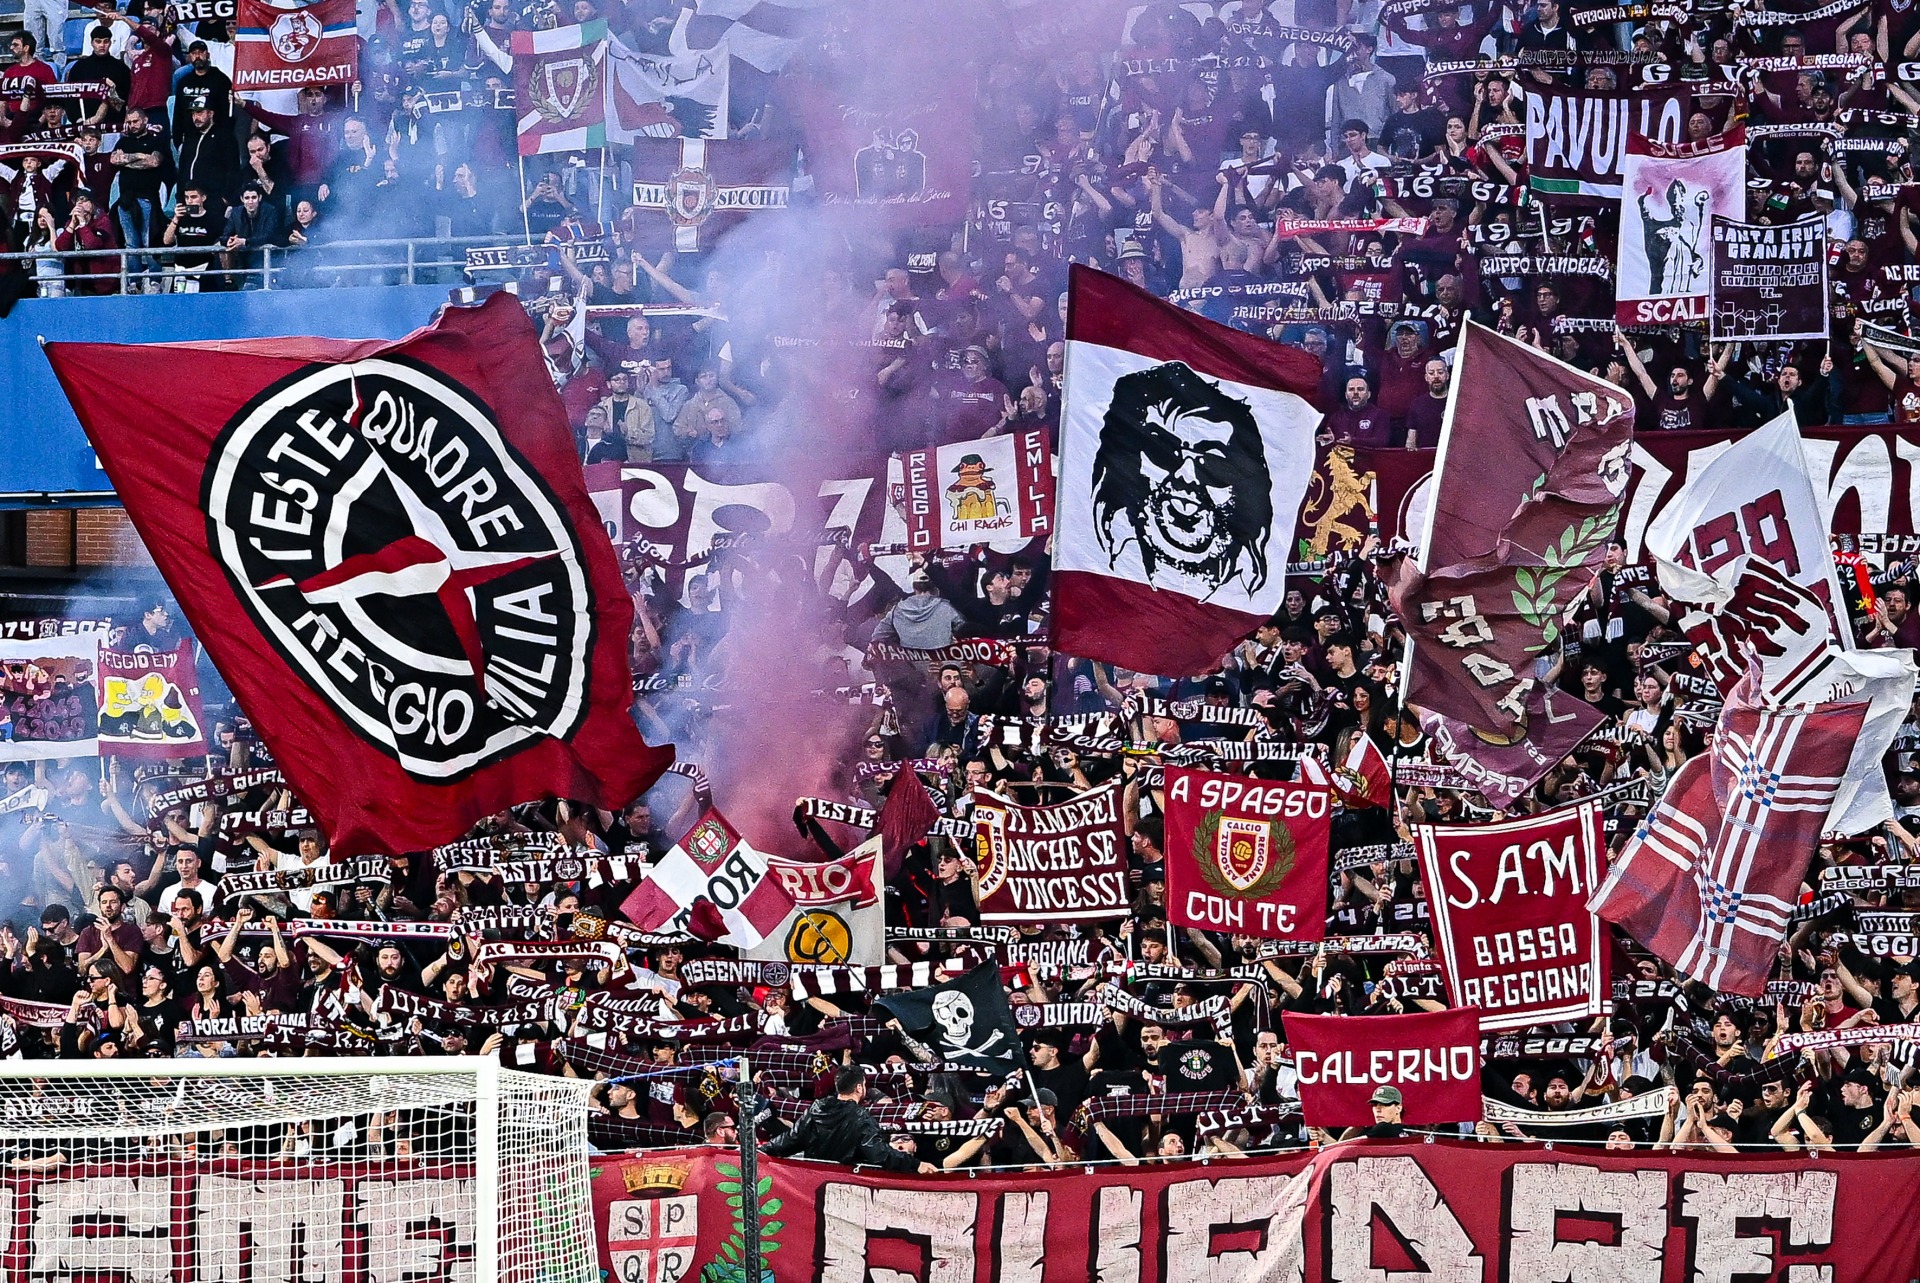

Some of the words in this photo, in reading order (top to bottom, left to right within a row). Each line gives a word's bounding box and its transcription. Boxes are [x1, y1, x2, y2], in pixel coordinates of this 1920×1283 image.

[237, 64, 352, 84] IMMERGASATI
[1835, 139, 1884, 151] REGGIANA
[635, 186, 663, 203] VAL
[1713, 226, 1775, 244] SANTA
[1781, 223, 1824, 243] CRUZ
[1728, 241, 1813, 260] GRANATA
[1720, 275, 1779, 287] SQUADRONI
[1779, 275, 1797, 287] MA
[1797, 273, 1820, 286] TIFO
[1733, 264, 1756, 276] NON
[1757, 264, 1782, 276] TIFO
[1782, 262, 1803, 276] PER
[1803, 261, 1819, 275] GLI
[361, 390, 525, 548] QUADRE
[1024, 430, 1049, 533] EMILIA
[909, 452, 931, 547] REGGIO
[950, 520, 968, 532] CHI
[973, 515, 1014, 531] RAGAS
[949, 641, 992, 661] ODIO
[1170, 775, 1189, 802] A
[1200, 779, 1328, 818] SPASSO
[804, 797, 876, 829] TESTE
[1006, 806, 1028, 835] TI
[1226, 821, 1262, 832] CALCIO
[980, 825, 1001, 894] REGGIANA
[1007, 833, 1085, 873] ANCHE
[1089, 829, 1118, 867] SE
[1243, 835, 1266, 883] REGGIANA
[1010, 871, 1129, 911] VINCESSI
[1823, 878, 1888, 890] REGGIO
[1186, 891, 1244, 929] CON
[1256, 902, 1296, 933] TE
[485, 944, 506, 957] AC
[515, 942, 601, 955] REGGIANA
[1473, 922, 1577, 968] BASSA
[680, 959, 762, 987] ASSENTI
[1463, 962, 1591, 1012] REGGIANA
[389, 988, 447, 1020] ULT
[194, 1016, 238, 1036] FORZA
[1783, 1032, 1838, 1052] FORZA
[1295, 1045, 1474, 1085] CALERNO
